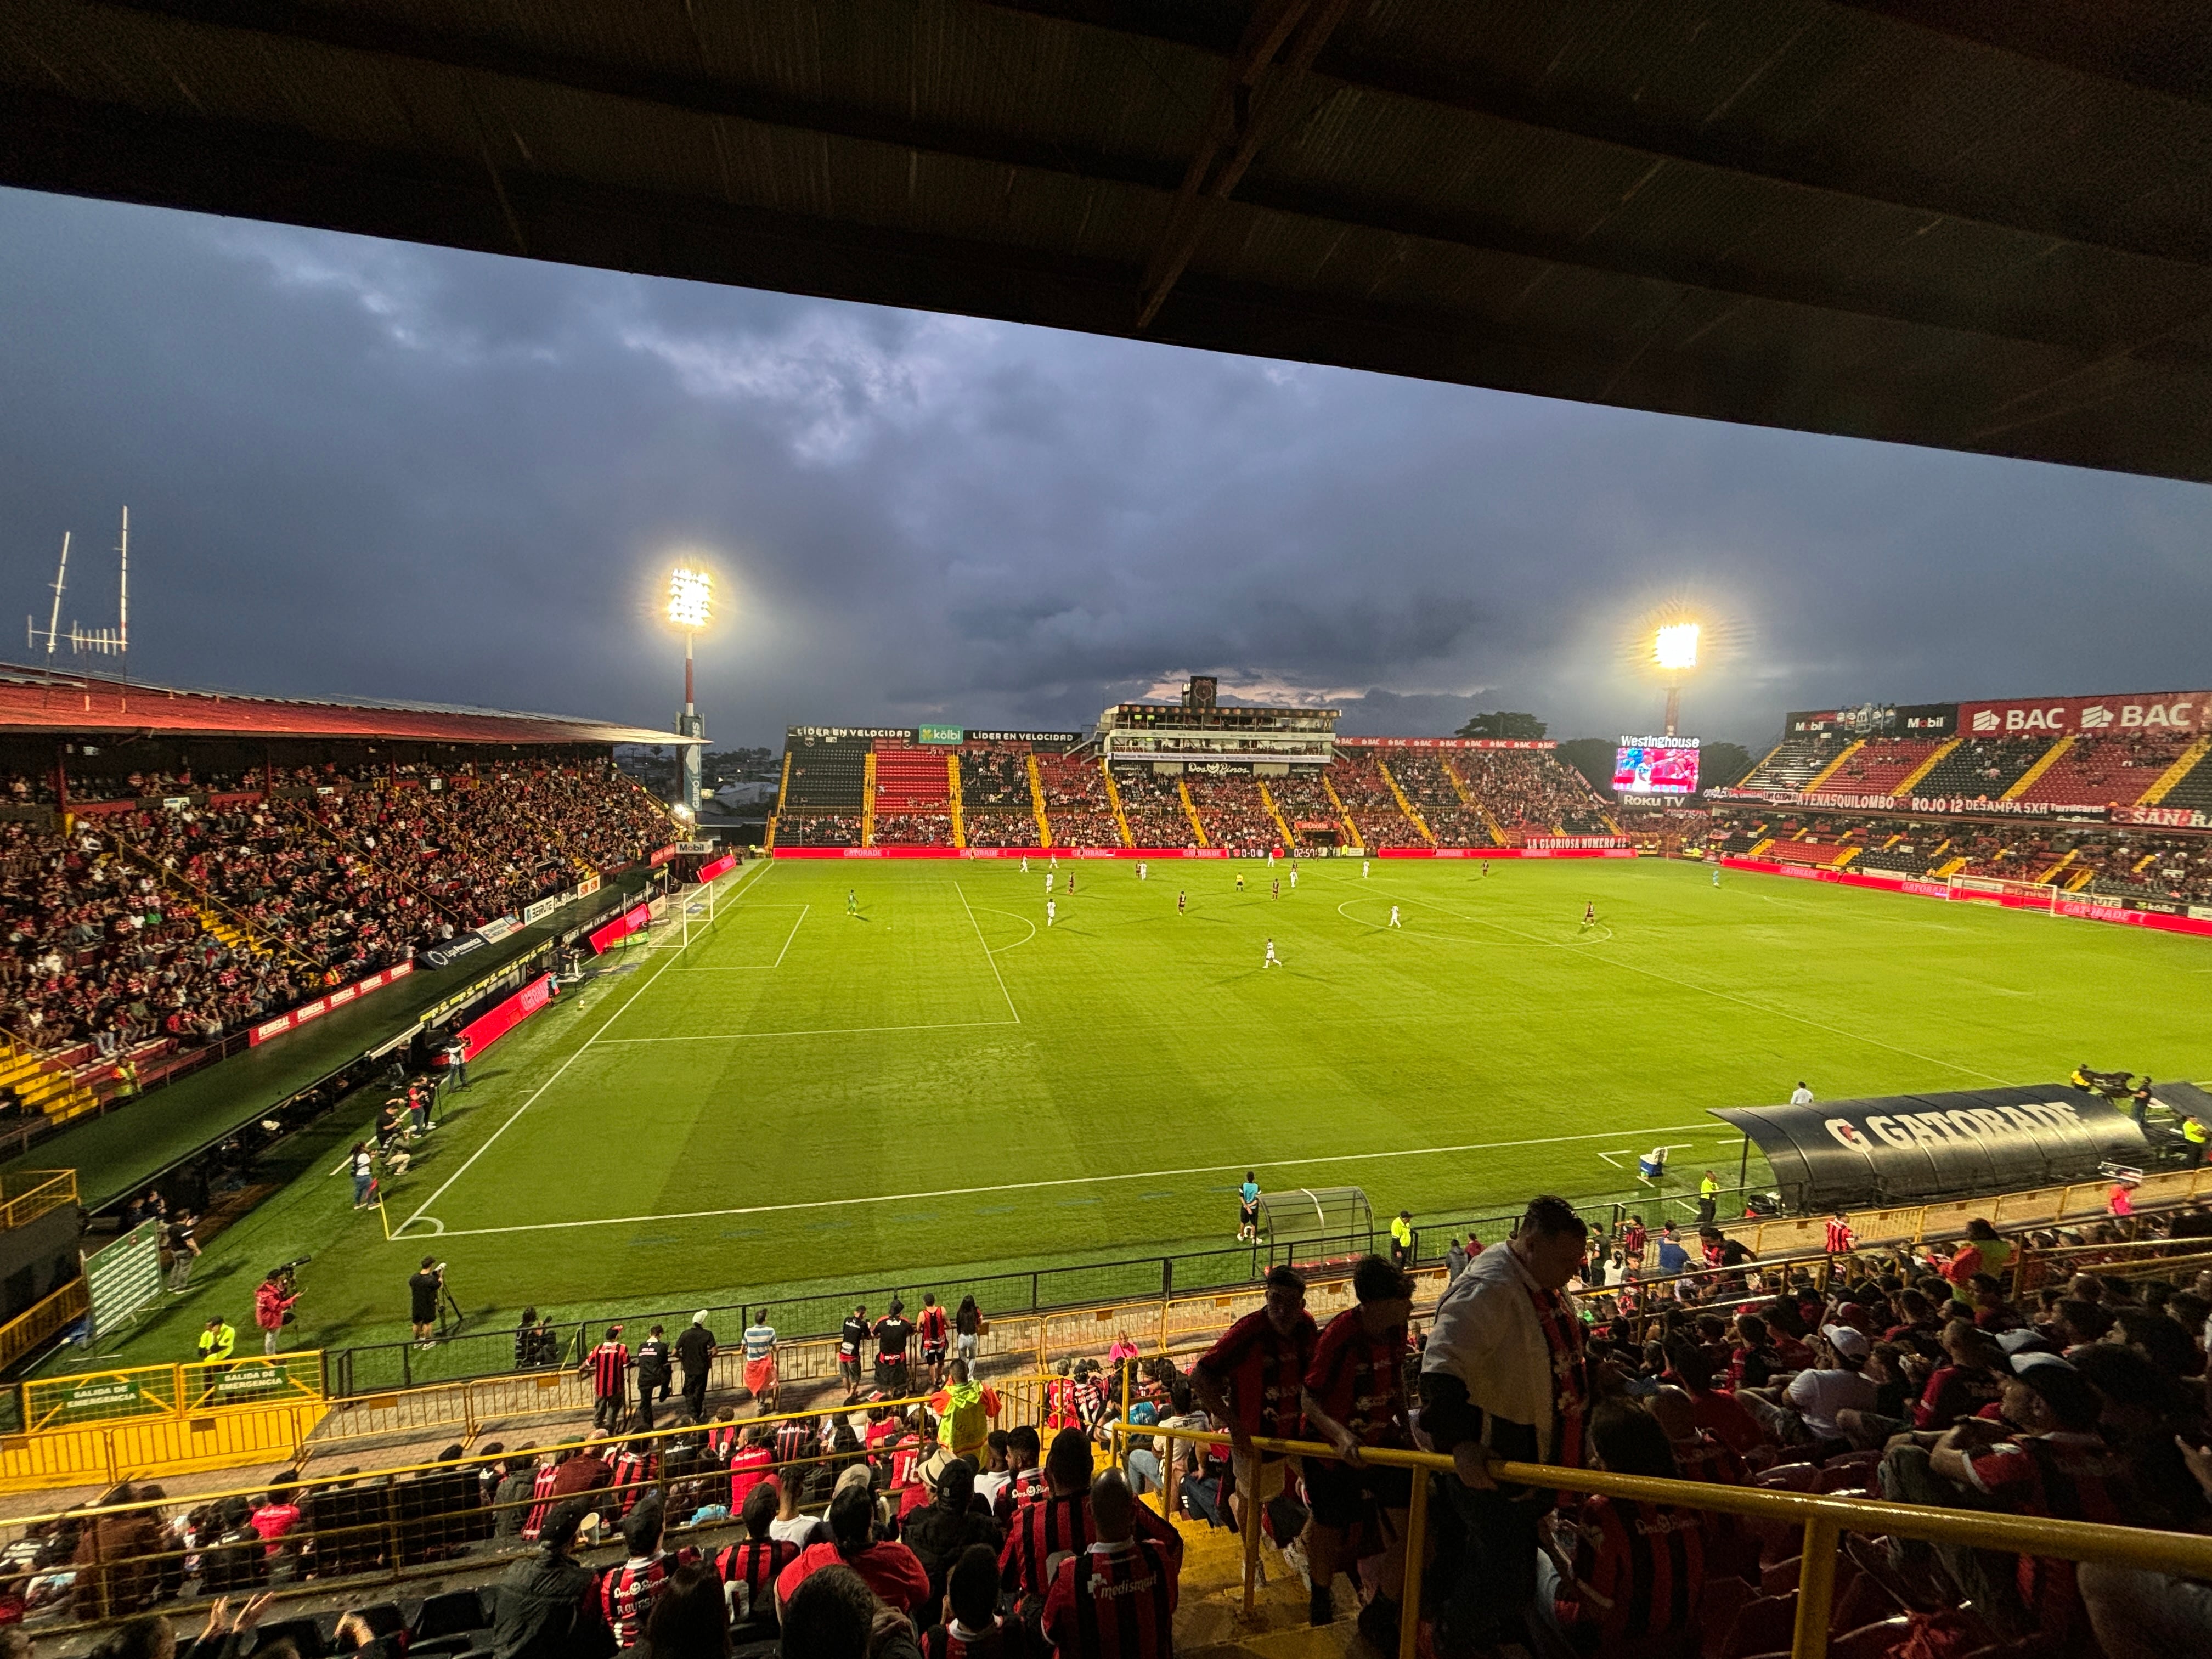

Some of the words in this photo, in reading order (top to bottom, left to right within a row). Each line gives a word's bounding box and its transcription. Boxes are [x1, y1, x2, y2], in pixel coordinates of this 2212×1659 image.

[2006, 708, 2064, 730] BAC
[2121, 703, 2193, 727] BAC
[1795, 722, 1824, 731] Mobil
[1907, 717, 1944, 728] Mobil
[933, 730, 960, 740] kölbi
[973, 731, 1001, 740] LÍDER
[1621, 735, 1700, 748] Westinghouse
[1188, 763, 1207, 773] Dos
[1220, 763, 1250, 774] Pinos
[1664, 796, 1685, 807] TV
[1797, 793, 1837, 807] ATENAS
[1838, 795, 1894, 809] QUILOMBO
[1912, 798, 1946, 812] ROJO
[1950, 798, 1963, 813] 12
[1966, 799, 2022, 814] DESAMPA
[2132, 811, 2180, 826] SAN
[1527, 838, 1539, 849] LA
[1540, 838, 1579, 849] GLORIOSA
[1582, 838, 1616, 849] NUMERO
[1617, 838, 1627, 848] 12
[1294, 849, 1314, 857] 02:57
[1780, 866, 1819, 879] GATORADE
[1865, 1102, 2089, 1150] GATORADE
[224, 1372, 259, 1382] SALIDA
[219, 1378, 283, 1391] EMERGENCIA
[74, 1387, 111, 1399] SALIDA
[114, 1385, 128, 1394] DE
[67, 1393, 137, 1408] EMERGENCIA
[1012, 1489, 1026, 1499] Dos
[1035, 1483, 1049, 1494] Pin
[614, 1587, 630, 1599] Dos
[640, 1575, 669, 1592] Pinos
[1101, 1571, 1157, 1601] medismart
